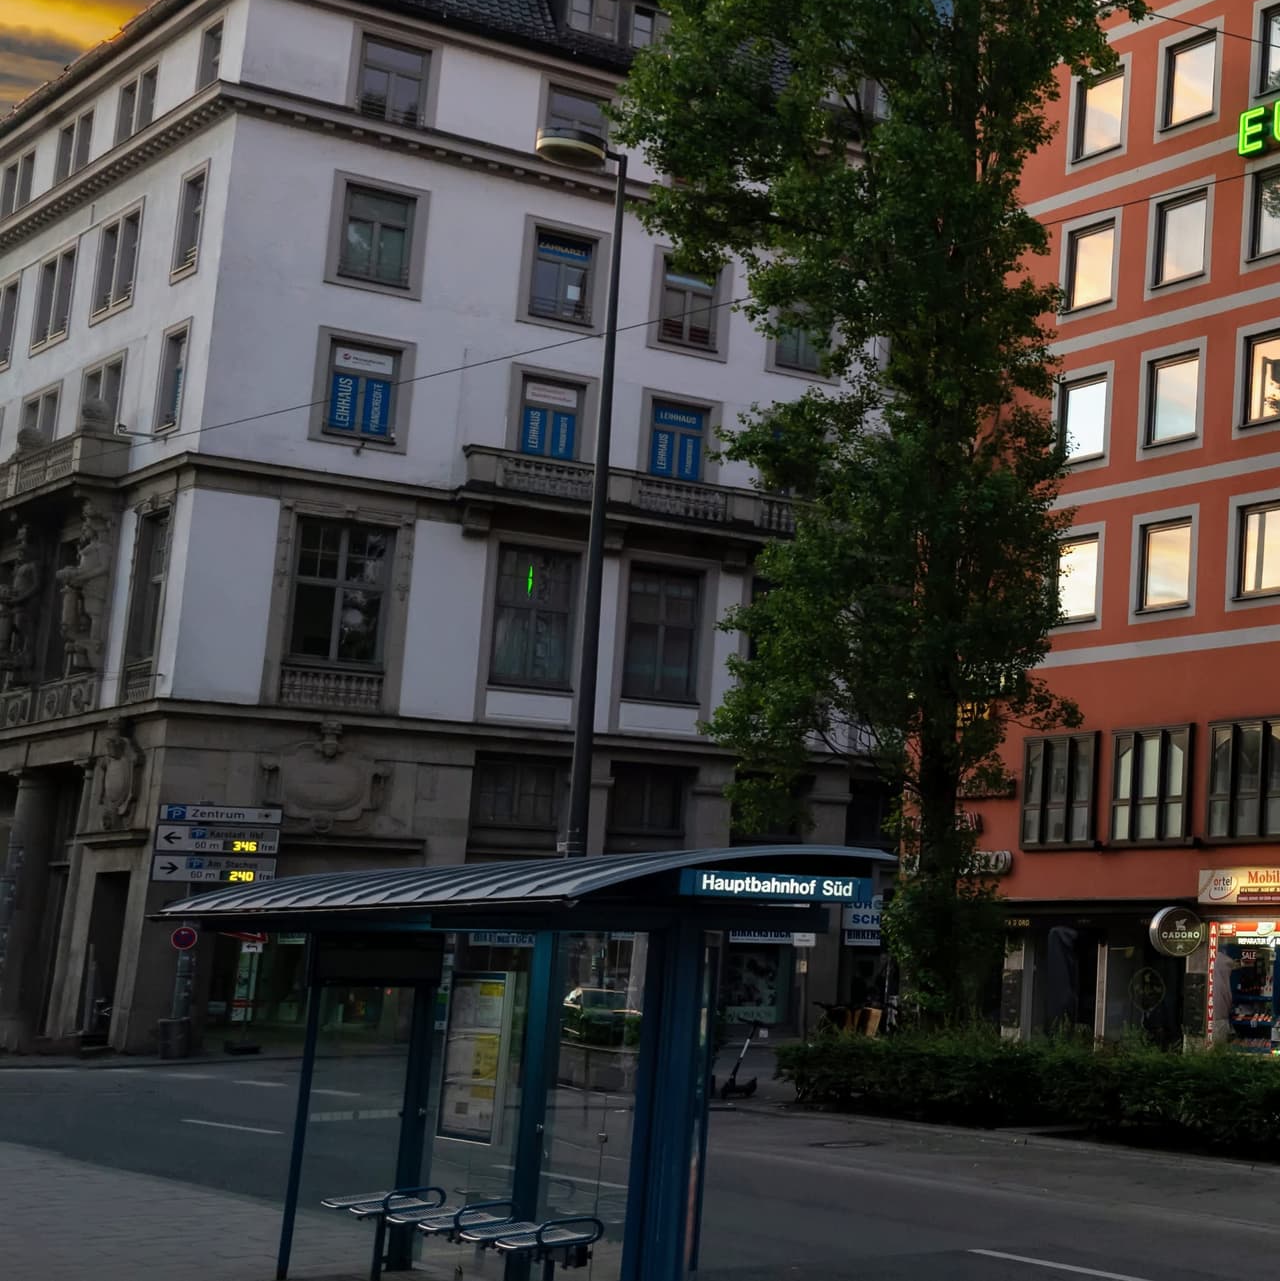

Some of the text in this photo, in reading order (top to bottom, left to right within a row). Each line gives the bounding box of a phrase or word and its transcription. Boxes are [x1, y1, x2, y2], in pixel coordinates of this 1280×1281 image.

[336, 377, 353, 427] LEIHHAUS
[191, 809, 245, 819] Zentrum
[233, 841, 257, 852] 346
[261, 842, 275, 851] frei
[207, 859, 221, 867] Am
[229, 871, 254, 882] 240
[1213, 876, 1232, 886] ortel
[702, 873, 853, 897] Hauptbahnhof Süd
[1161, 931, 1200, 939] CADORO
[1241, 951, 1256, 960] SALE
